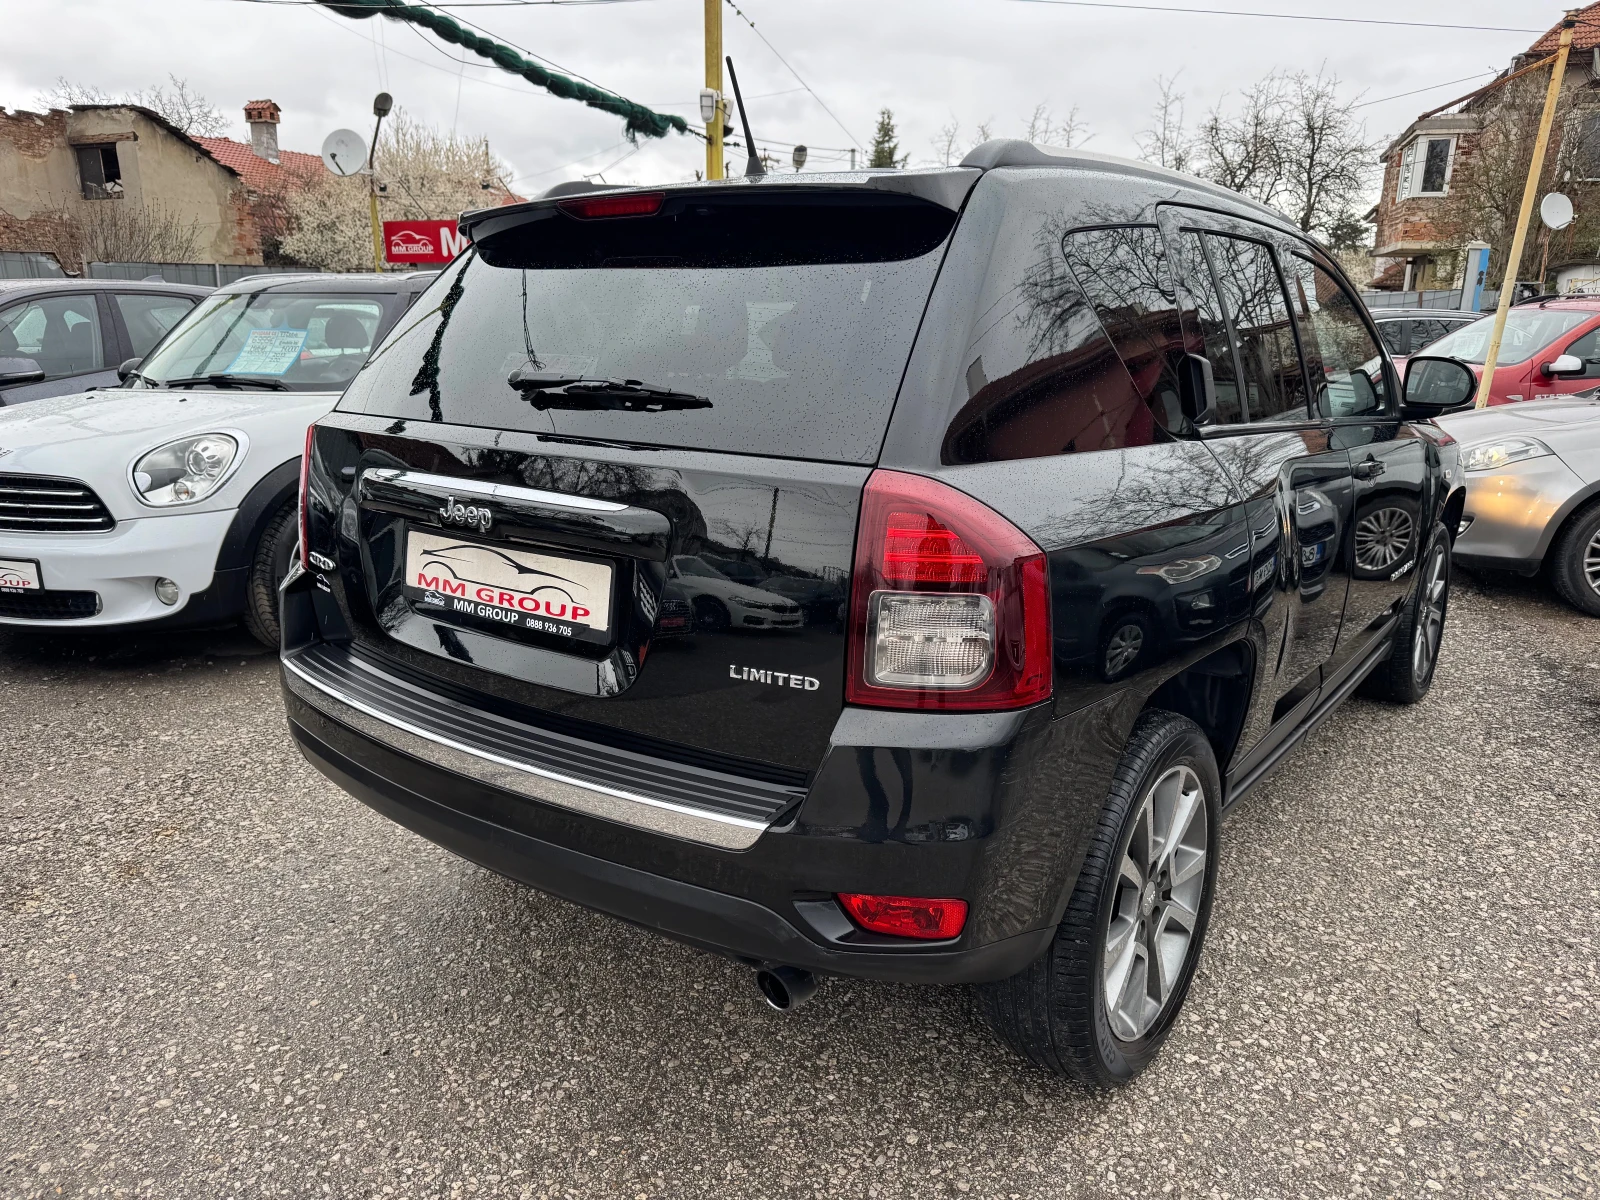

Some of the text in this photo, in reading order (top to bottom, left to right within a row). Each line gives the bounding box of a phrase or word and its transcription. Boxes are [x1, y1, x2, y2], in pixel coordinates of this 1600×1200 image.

[391, 245, 434, 253] MM GROUP
[440, 495, 492, 535] Jeep
[417, 572, 591, 621] MM GROUP
[453, 598, 475, 614] MM
[477, 605, 519, 624] GROUP
[526, 618, 543, 630] 0888
[544, 623, 557, 633] 936
[559, 625, 573, 637] 705
[729, 664, 820, 691] LIMITED
